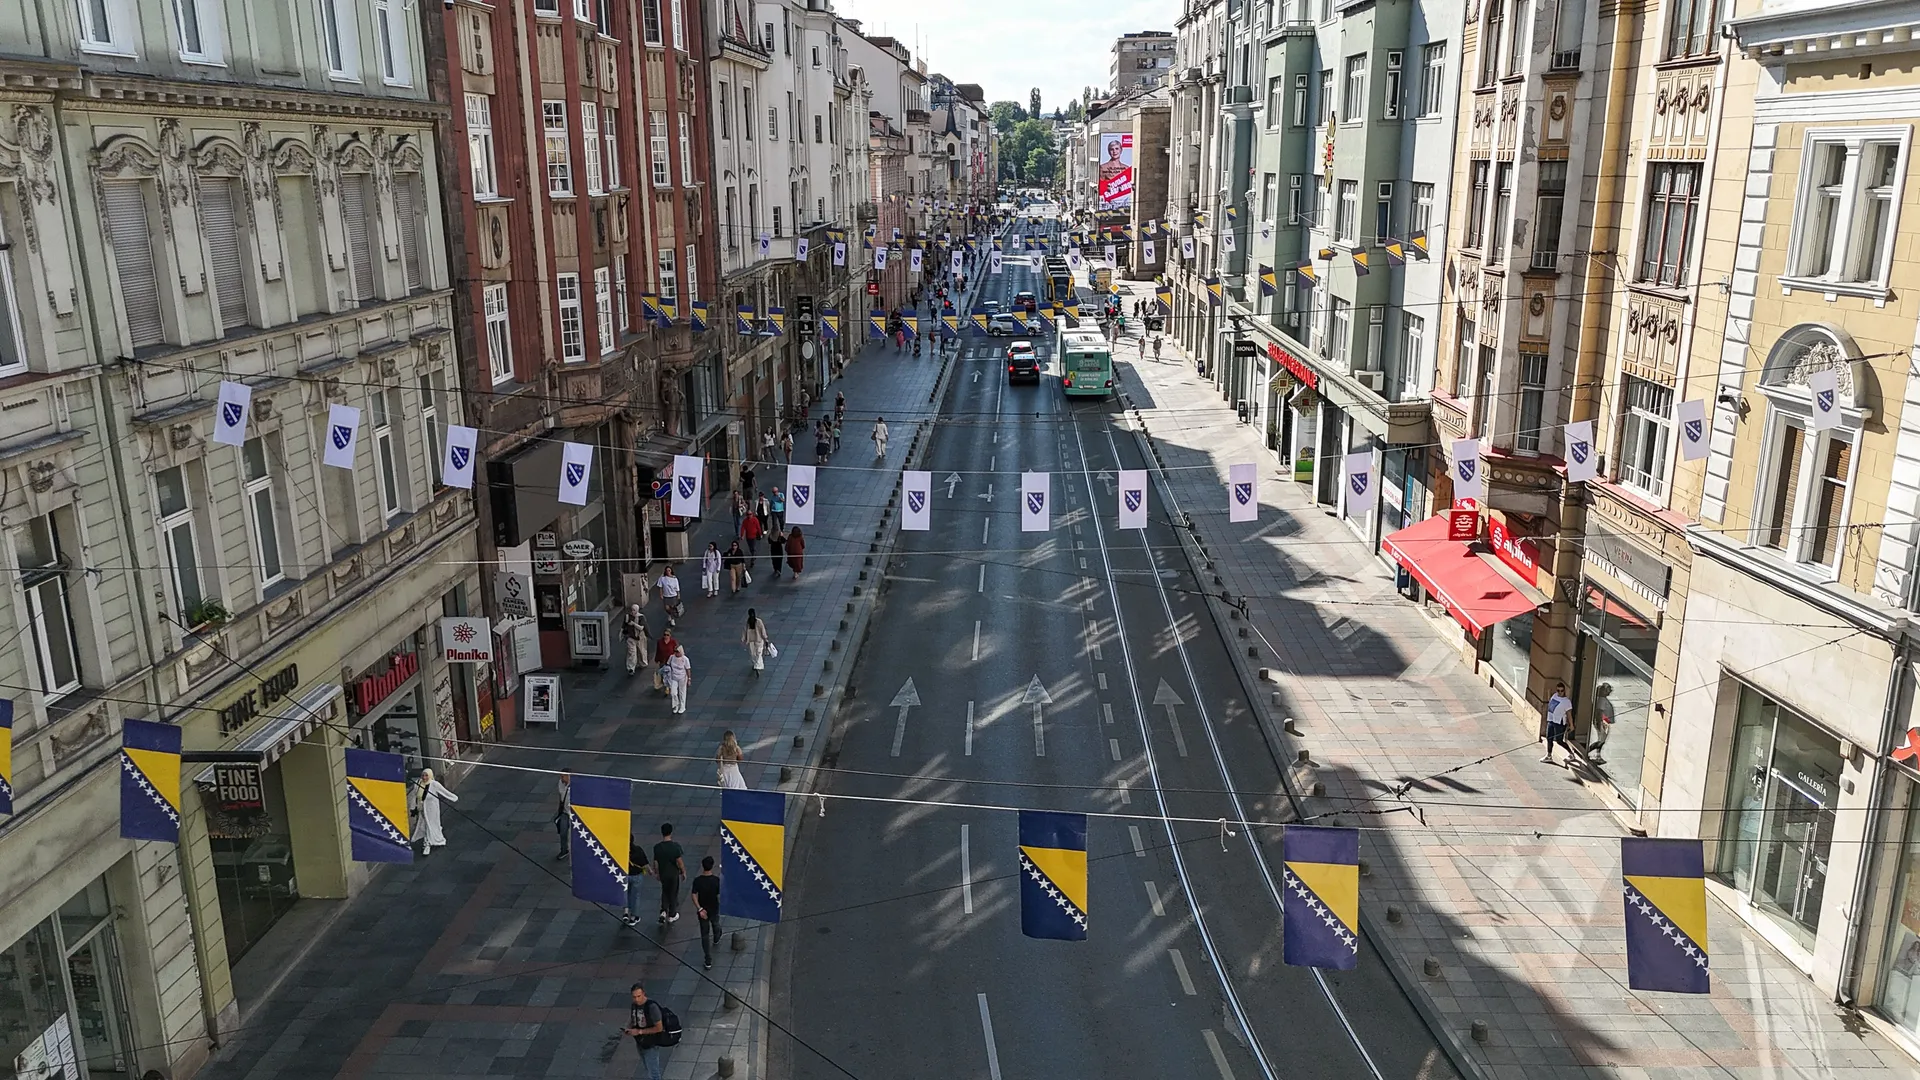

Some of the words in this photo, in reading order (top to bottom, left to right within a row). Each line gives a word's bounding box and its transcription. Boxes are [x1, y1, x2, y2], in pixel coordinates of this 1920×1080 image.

[1503, 539, 1533, 569] alpina
[446, 648, 489, 661] Planika
[361, 651, 417, 714] Planika
[217, 688, 259, 738] FINE
[258, 662, 299, 710] FOOD
[217, 769, 258, 786] FINE
[219, 785, 260, 801] FOOD
